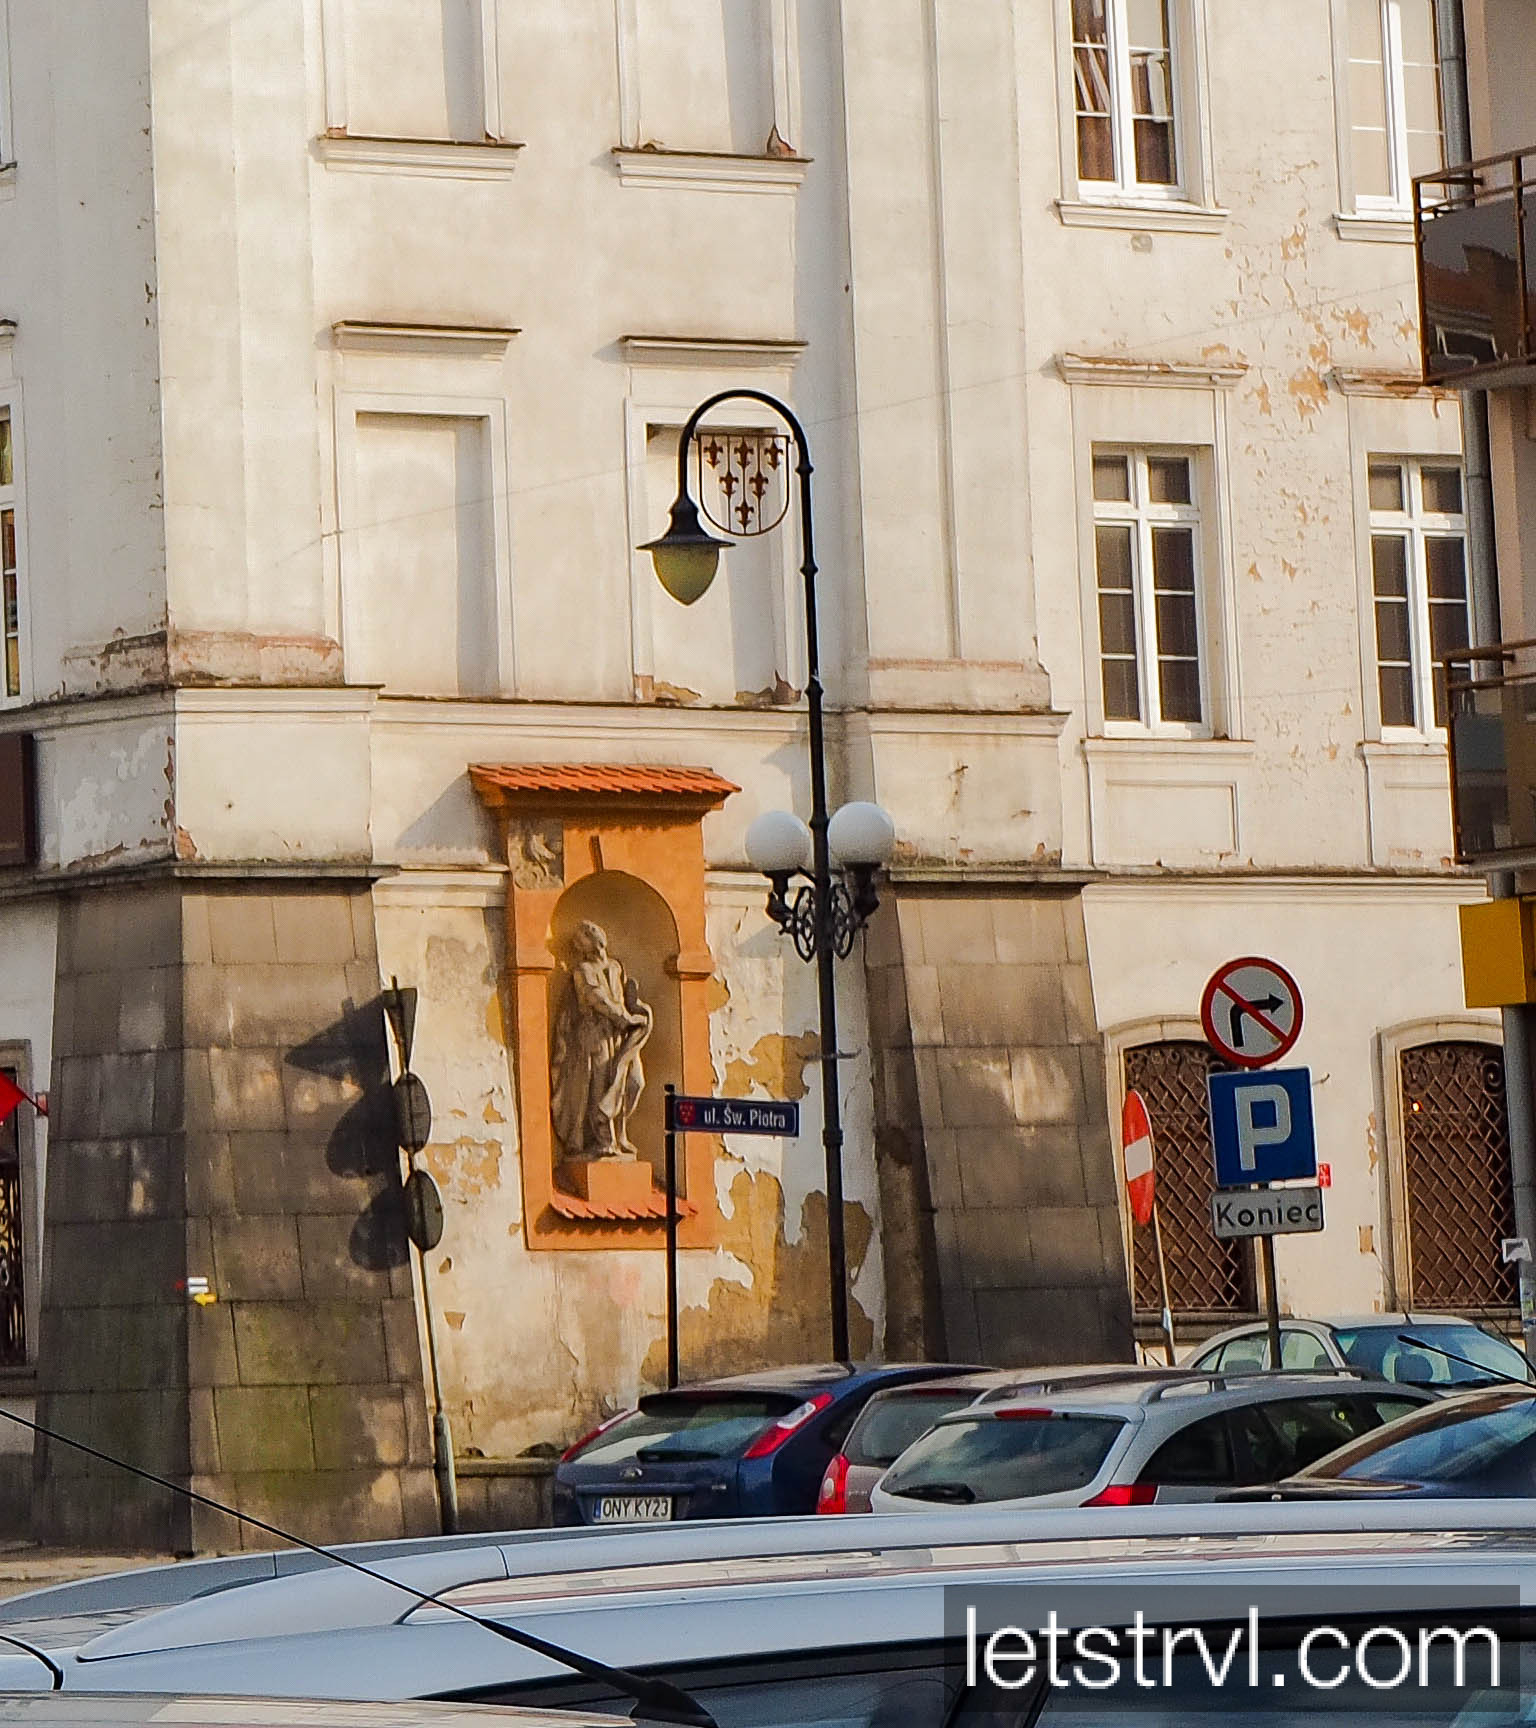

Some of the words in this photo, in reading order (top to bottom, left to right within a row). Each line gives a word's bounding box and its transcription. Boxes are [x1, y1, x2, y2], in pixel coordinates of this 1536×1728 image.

[704, 1107, 721, 1125] ul.
[724, 1102, 746, 1126] Św.
[749, 1109, 786, 1128] Piotra
[1234, 1084, 1292, 1171] P
[1215, 1199, 1320, 1229] Koniec
[603, 1499, 631, 1518] ONY
